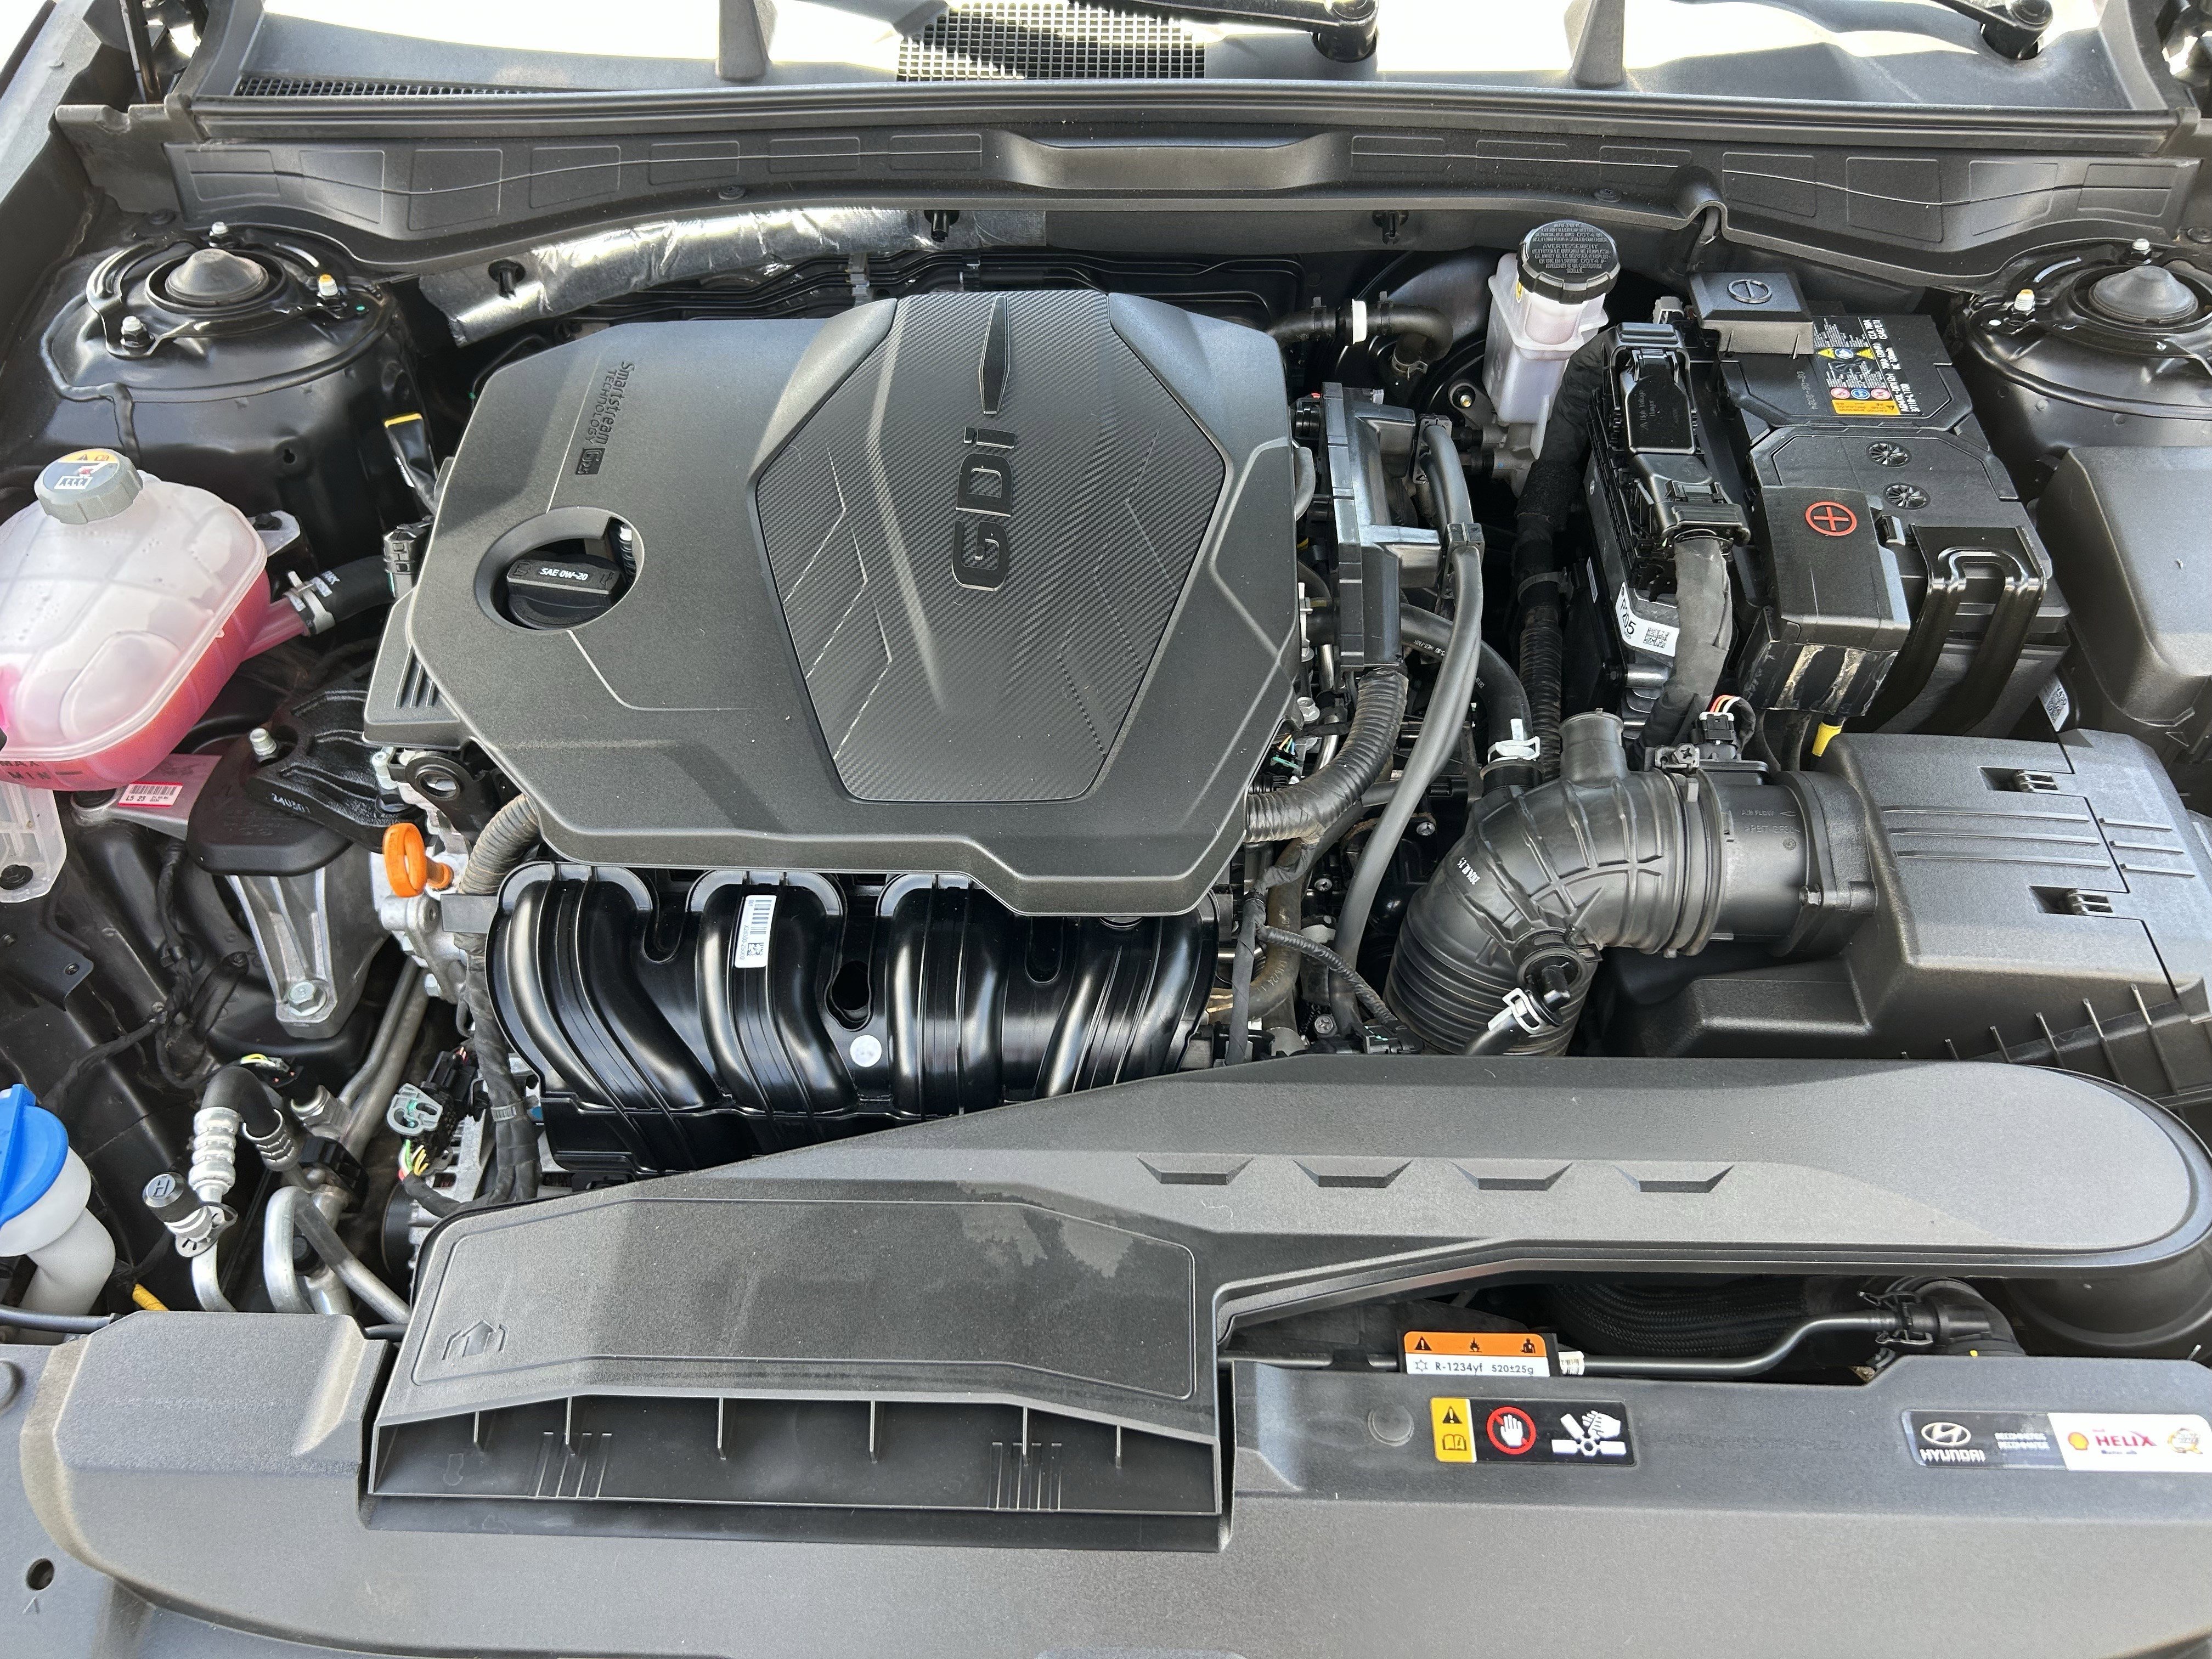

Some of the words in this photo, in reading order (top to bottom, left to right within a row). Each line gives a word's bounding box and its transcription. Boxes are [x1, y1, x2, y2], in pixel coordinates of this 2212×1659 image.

[585, 369, 617, 444] TECHNOLOGY
[596, 360, 635, 444] Smartstream
[952, 426, 1015, 591] GDi
[539, 568, 560, 577] SAE
[559, 570, 589, 581] 0W-20
[1620, 598, 1637, 635] P205
[153, 1180, 170, 1197] H
[1435, 1363, 1482, 1375] R-1234yf
[1491, 1363, 1534, 1375] 520±25g
[2095, 1432, 2157, 1447] HELIX
[1920, 1449, 1986, 1463] HYUNDAI
